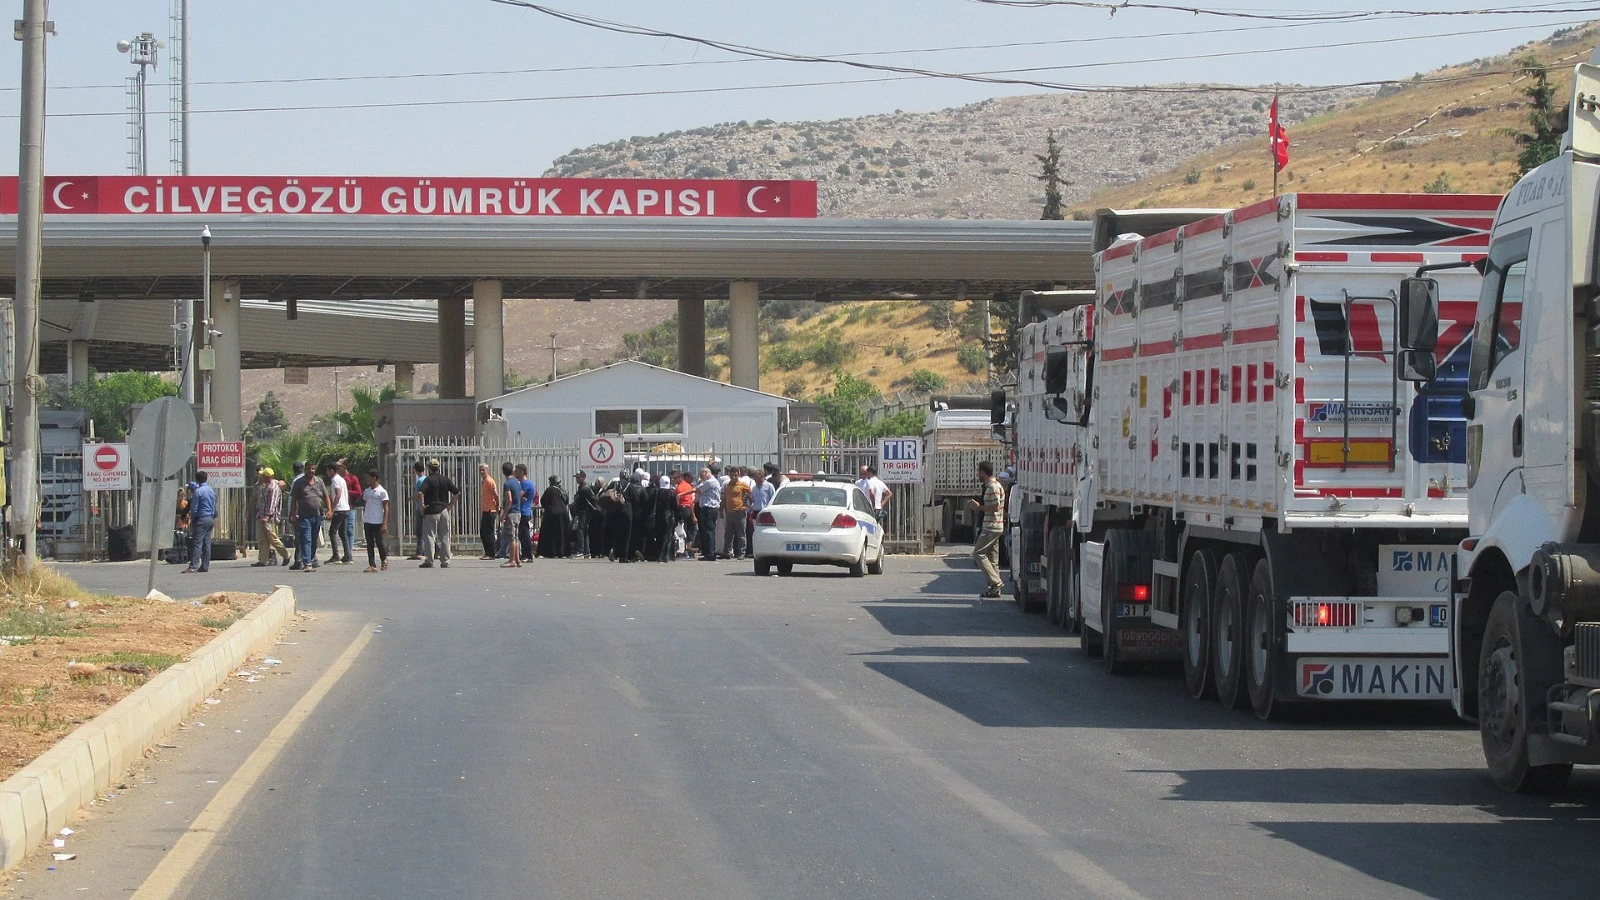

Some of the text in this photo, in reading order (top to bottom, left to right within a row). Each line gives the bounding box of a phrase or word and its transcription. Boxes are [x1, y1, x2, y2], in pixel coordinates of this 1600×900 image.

[123, 178, 715, 215] CİLVEGÖZÜ GÜMRÜK KAPISI
[203, 443, 239, 453] PROTOKOL
[885, 441, 916, 459] TIR
[201, 453, 241, 466] ARAÇ GİRİŞİ
[1124, 605, 1150, 616] 31 P
